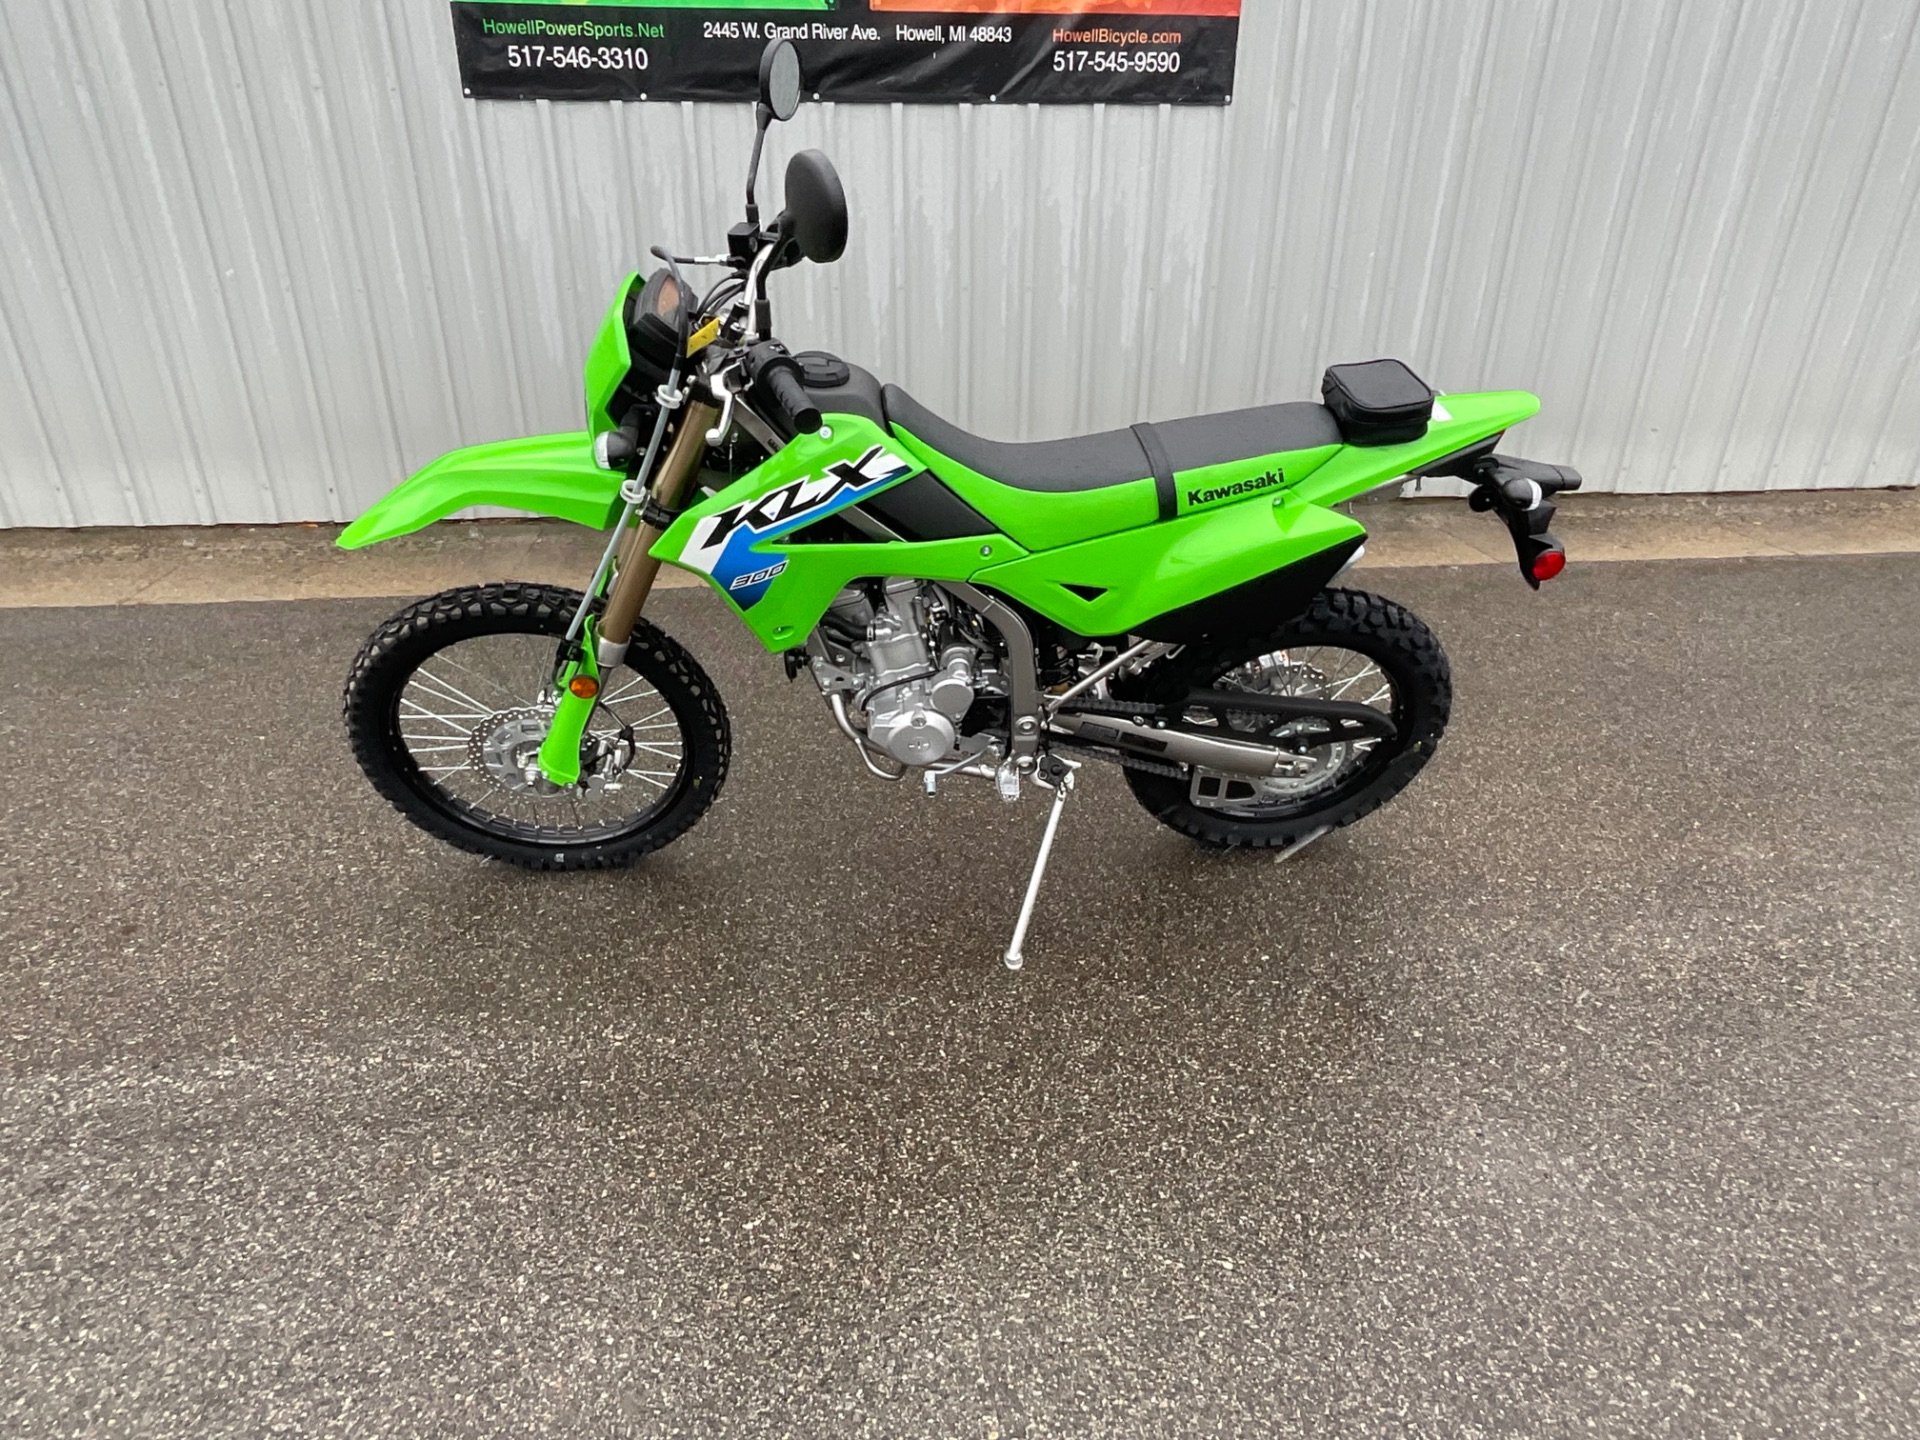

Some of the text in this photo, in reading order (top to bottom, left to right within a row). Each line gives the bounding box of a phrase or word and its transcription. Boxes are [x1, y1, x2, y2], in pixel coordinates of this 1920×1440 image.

[483, 18, 665, 40] HowellPowerSports.Net
[703, 22, 1012, 44] 2445 W. Grand River Ave. Howell, MI 48843
[1053, 28, 1182, 46] HowellBicycle.com
[507, 45, 649, 70] 517-546-3310
[1053, 51, 1180, 73] 517-545-9590
[699, 444, 885, 550] KLX
[1187, 468, 1285, 506] Kawasaki
[730, 560, 789, 591] 300
